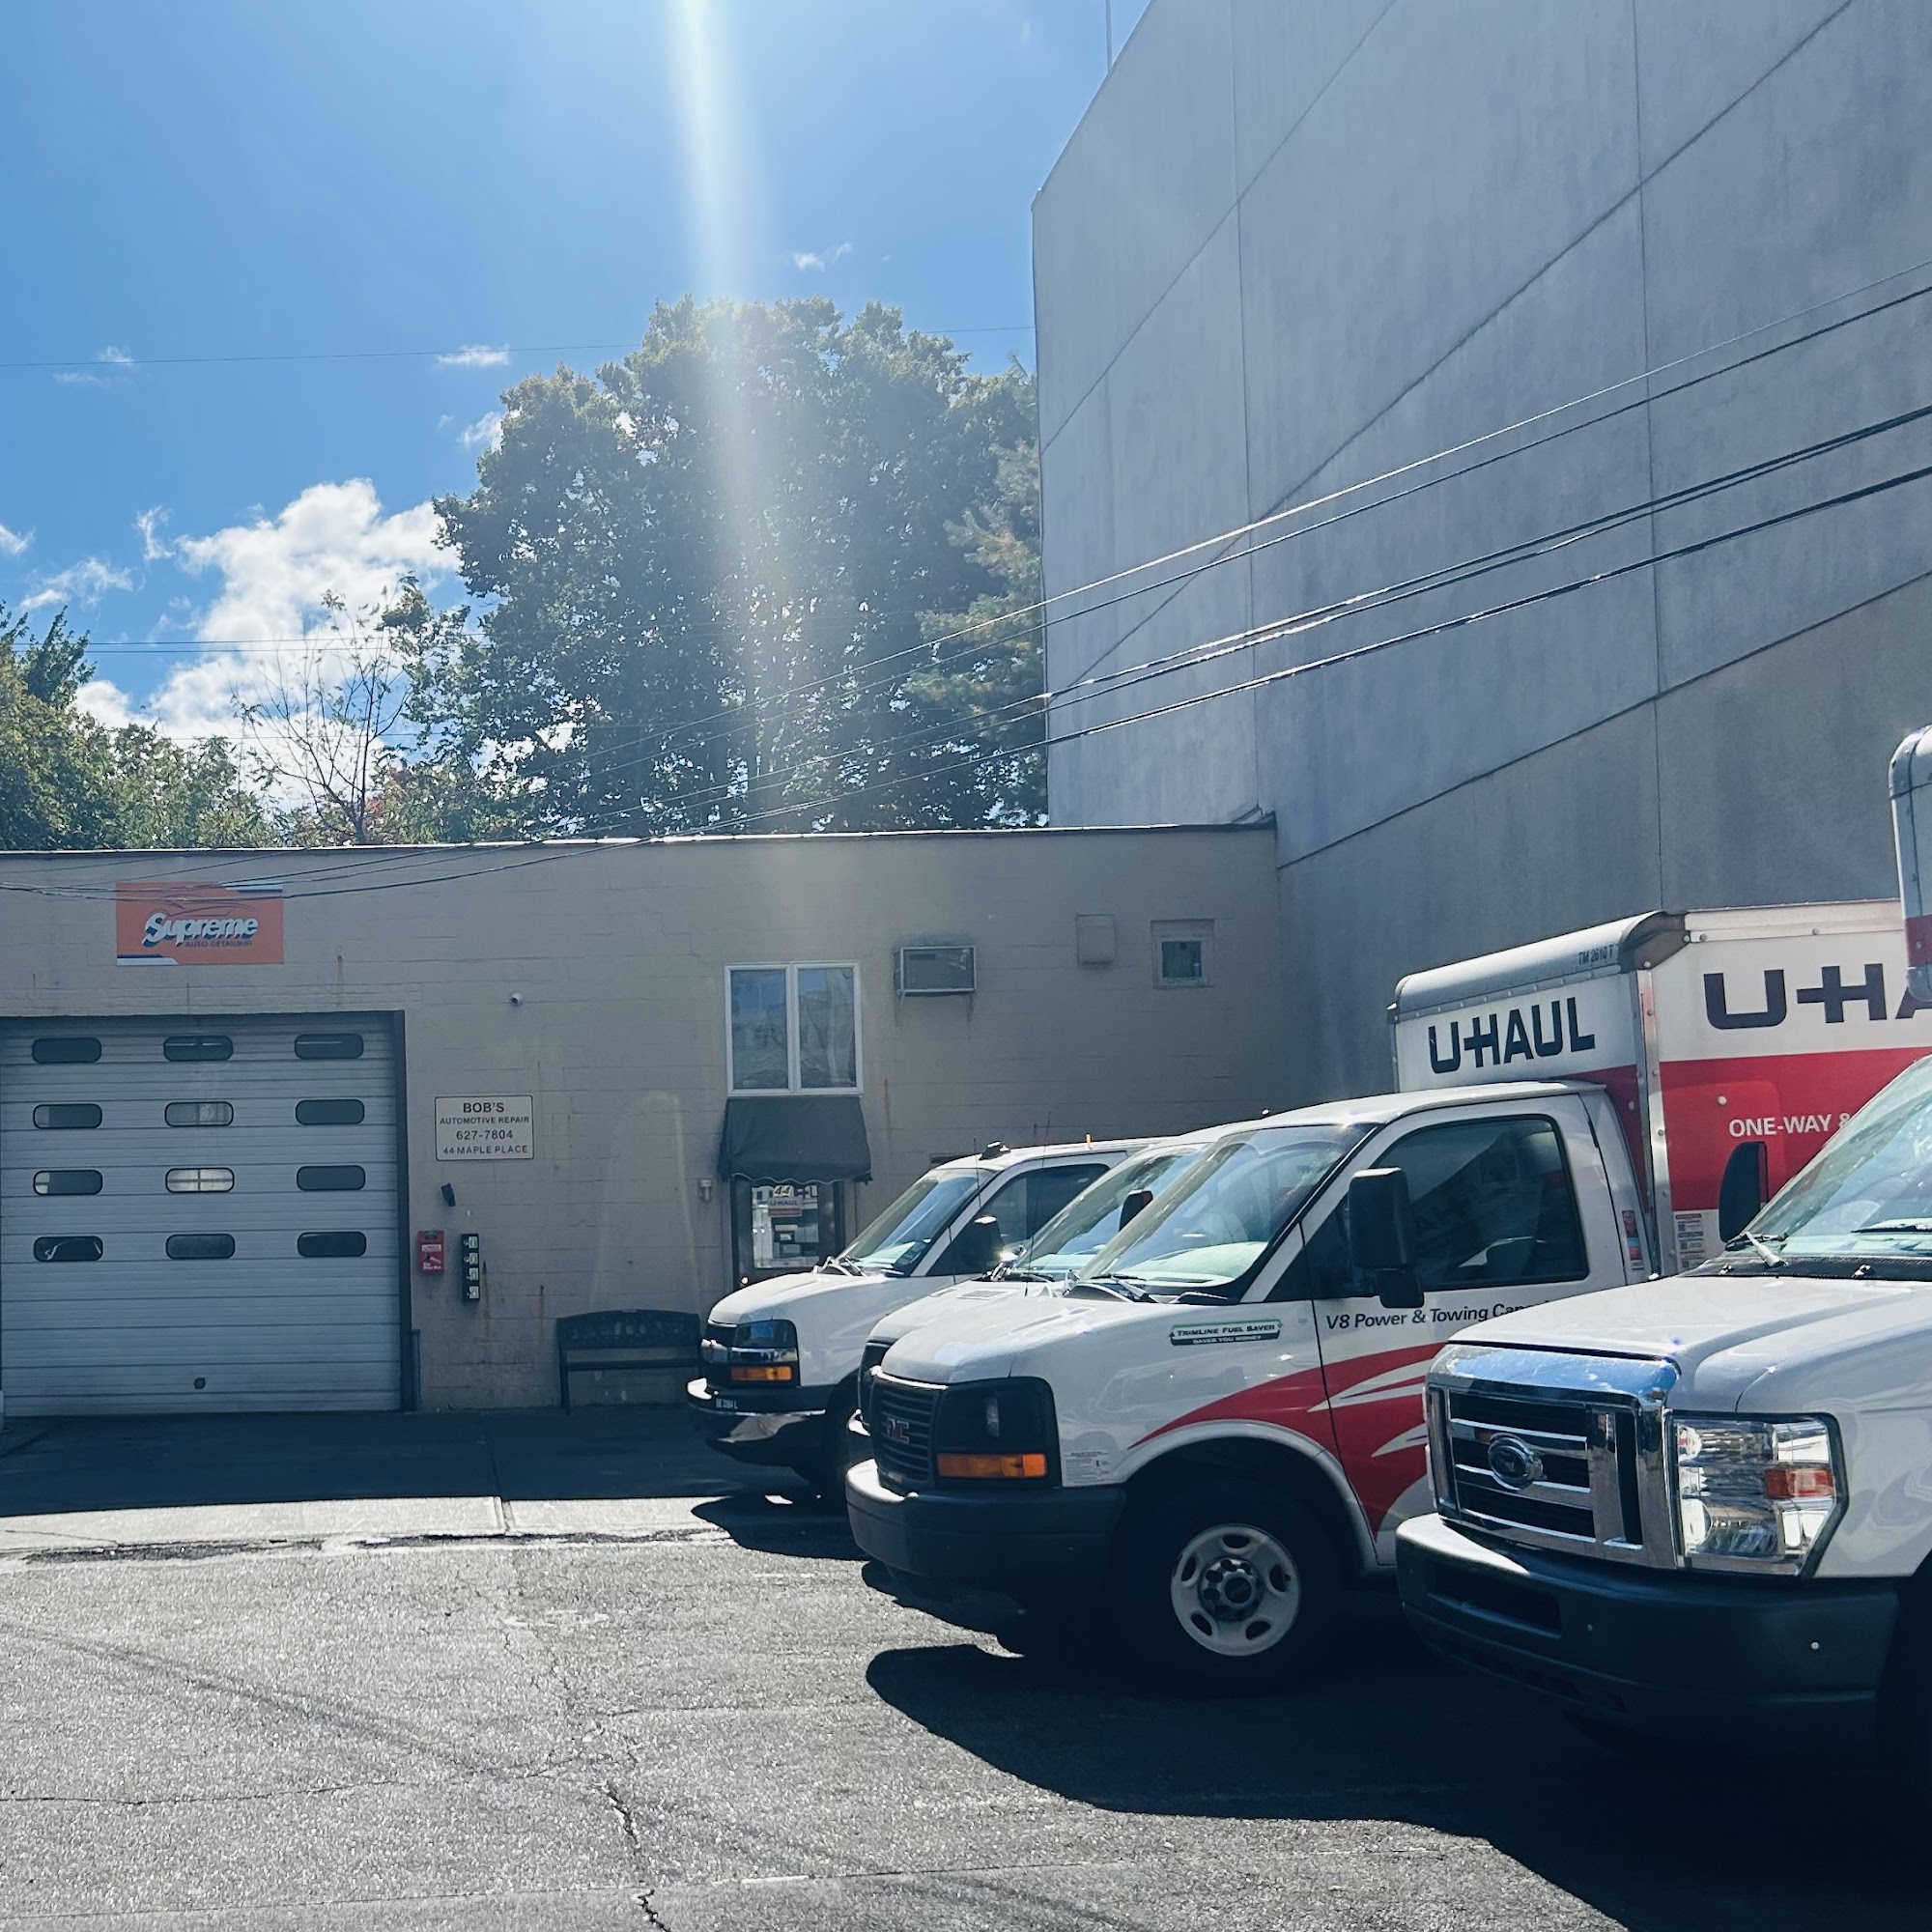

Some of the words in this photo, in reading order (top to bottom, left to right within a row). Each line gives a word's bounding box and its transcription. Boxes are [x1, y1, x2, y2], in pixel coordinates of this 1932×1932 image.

[142, 913, 259, 947] Supreme
[1428, 997, 1596, 1074] U-HAUL
[463, 1102, 505, 1113] BOB'S
[456, 1129, 513, 1140] 627-7804
[1728, 1114, 1833, 1138] ONE-WAY
[457, 1146, 493, 1154] MAPLE
[495, 1145, 527, 1153] PLACE
[1326, 1315, 1350, 1329] V8
[1354, 1313, 1406, 1328] Power
[1411, 1309, 1426, 1323] &
[1429, 1306, 1489, 1322] Towing
[1177, 1328, 1219, 1337] TRIMLINE
